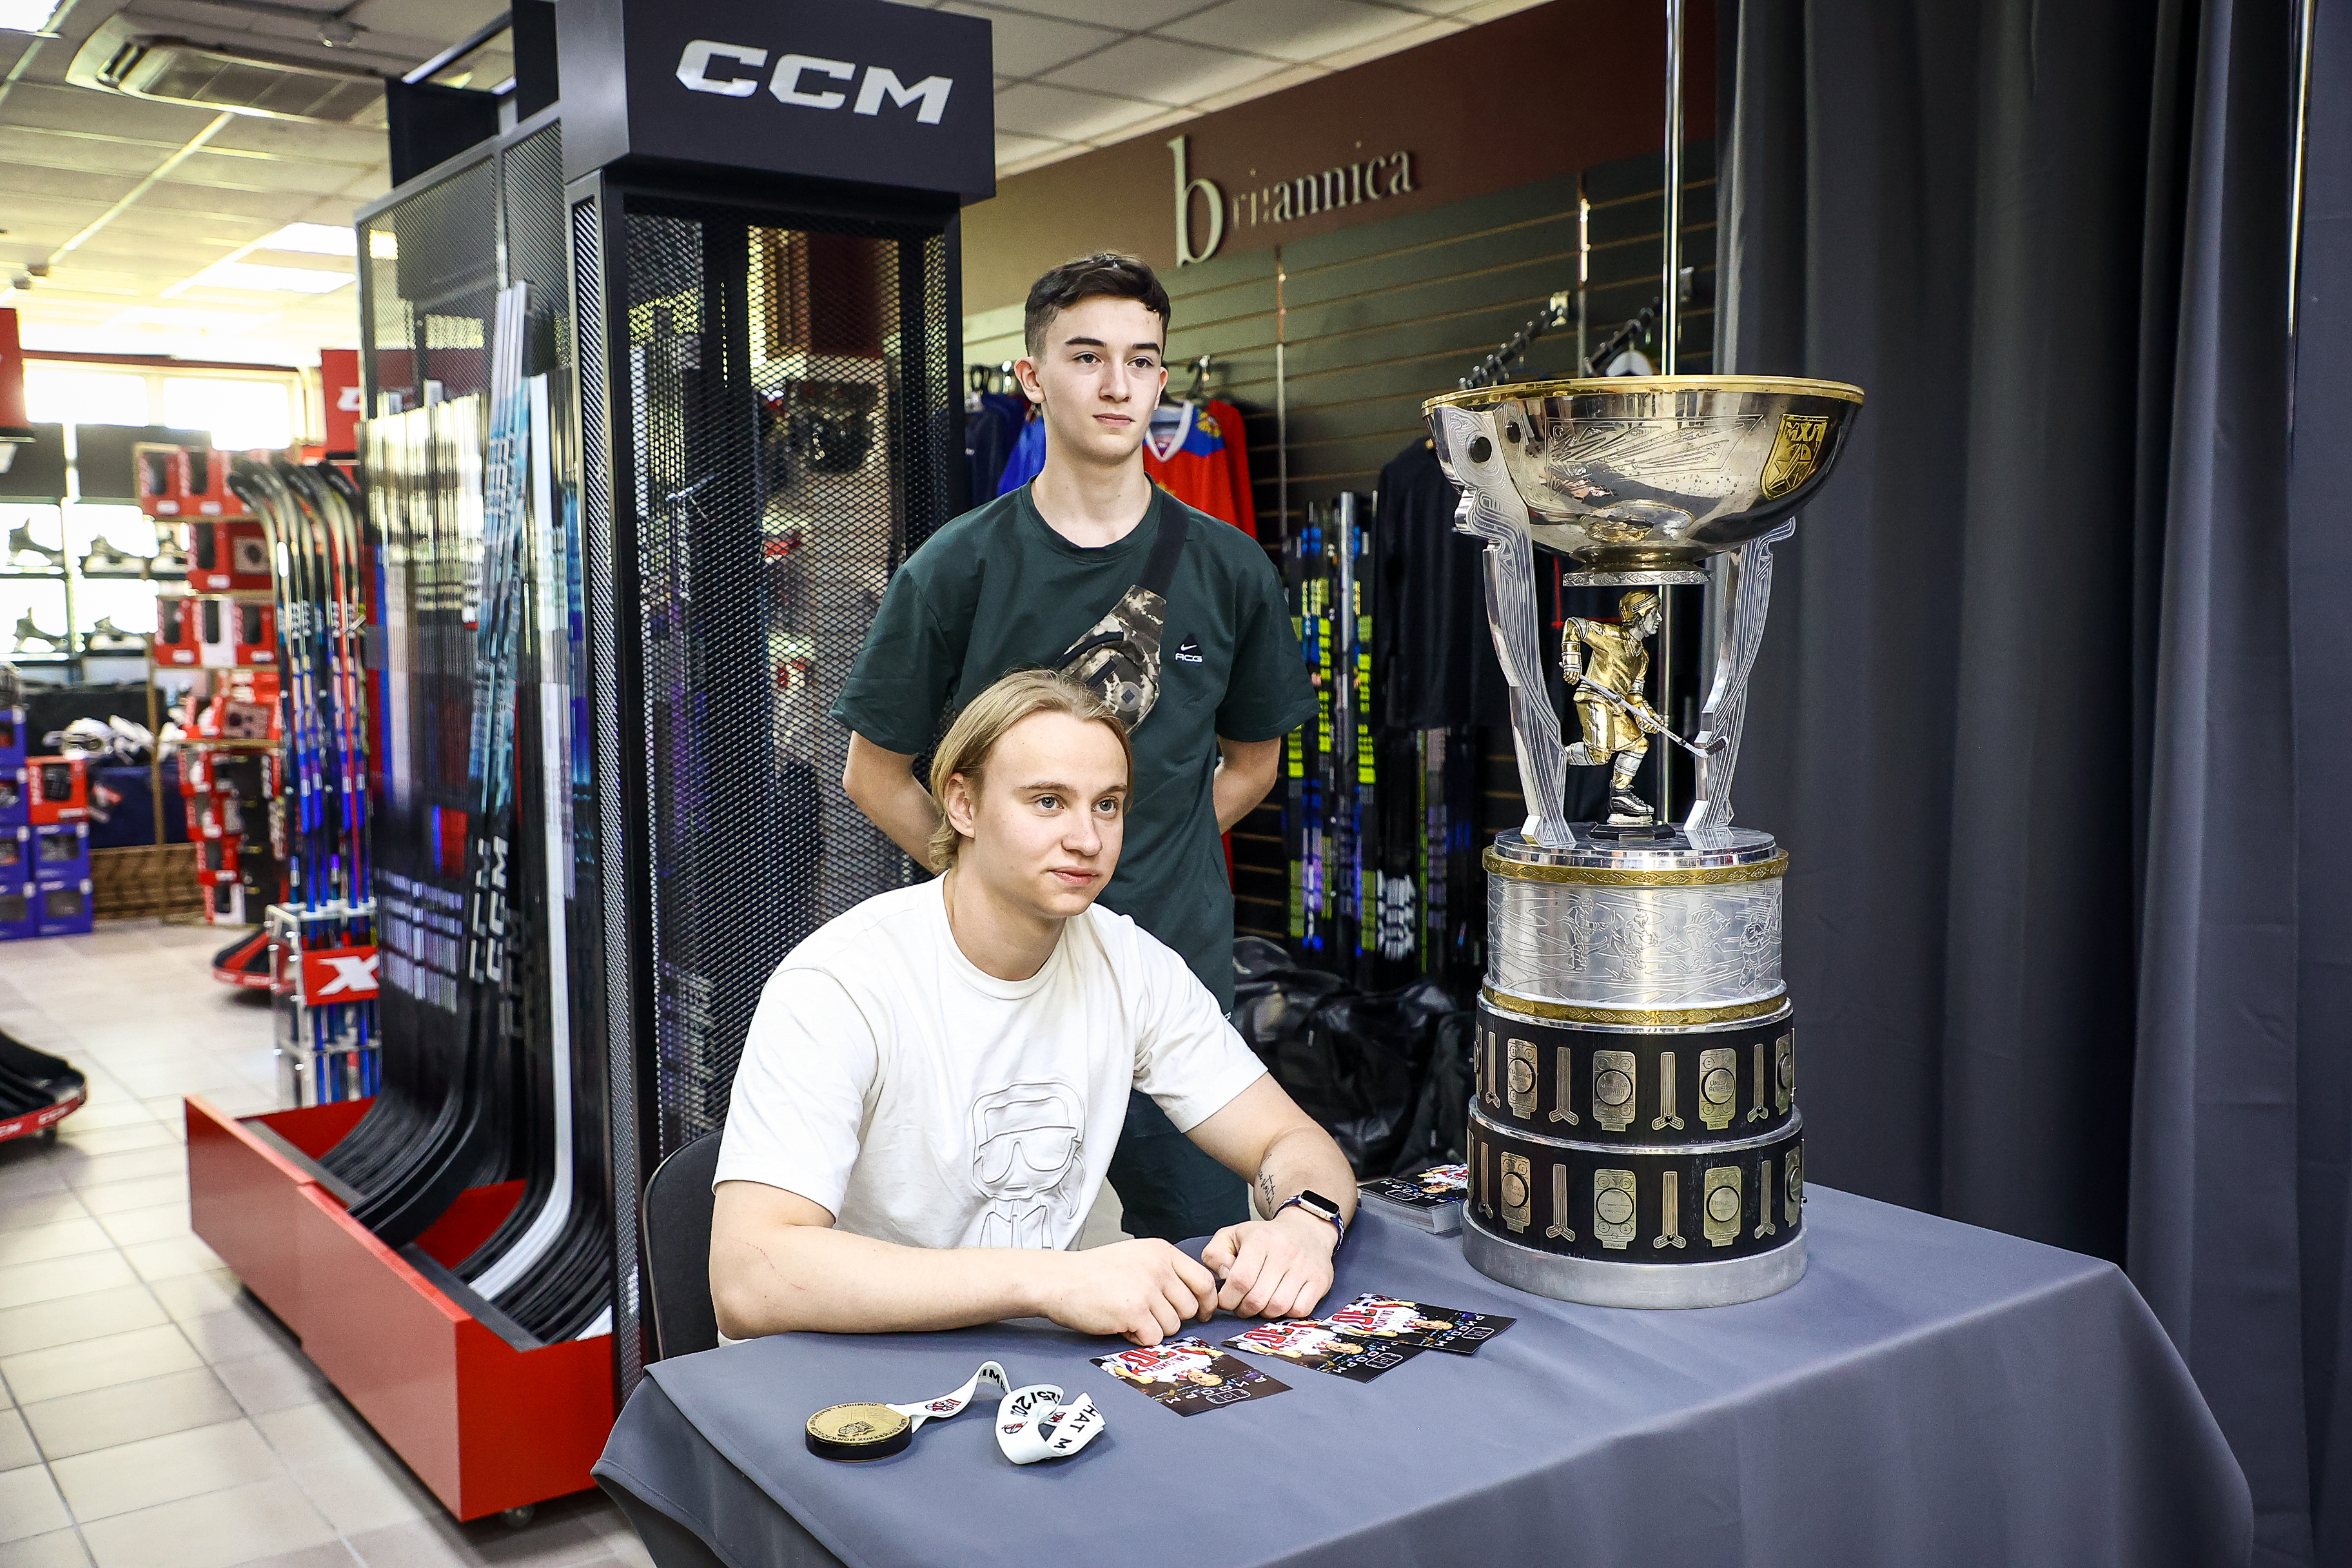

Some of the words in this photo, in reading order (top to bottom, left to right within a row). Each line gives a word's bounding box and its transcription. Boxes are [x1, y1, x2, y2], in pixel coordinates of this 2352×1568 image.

[675, 39, 954, 124] CCM
[1175, 652, 1203, 663] ACG
[486, 836, 509, 983] CCM
